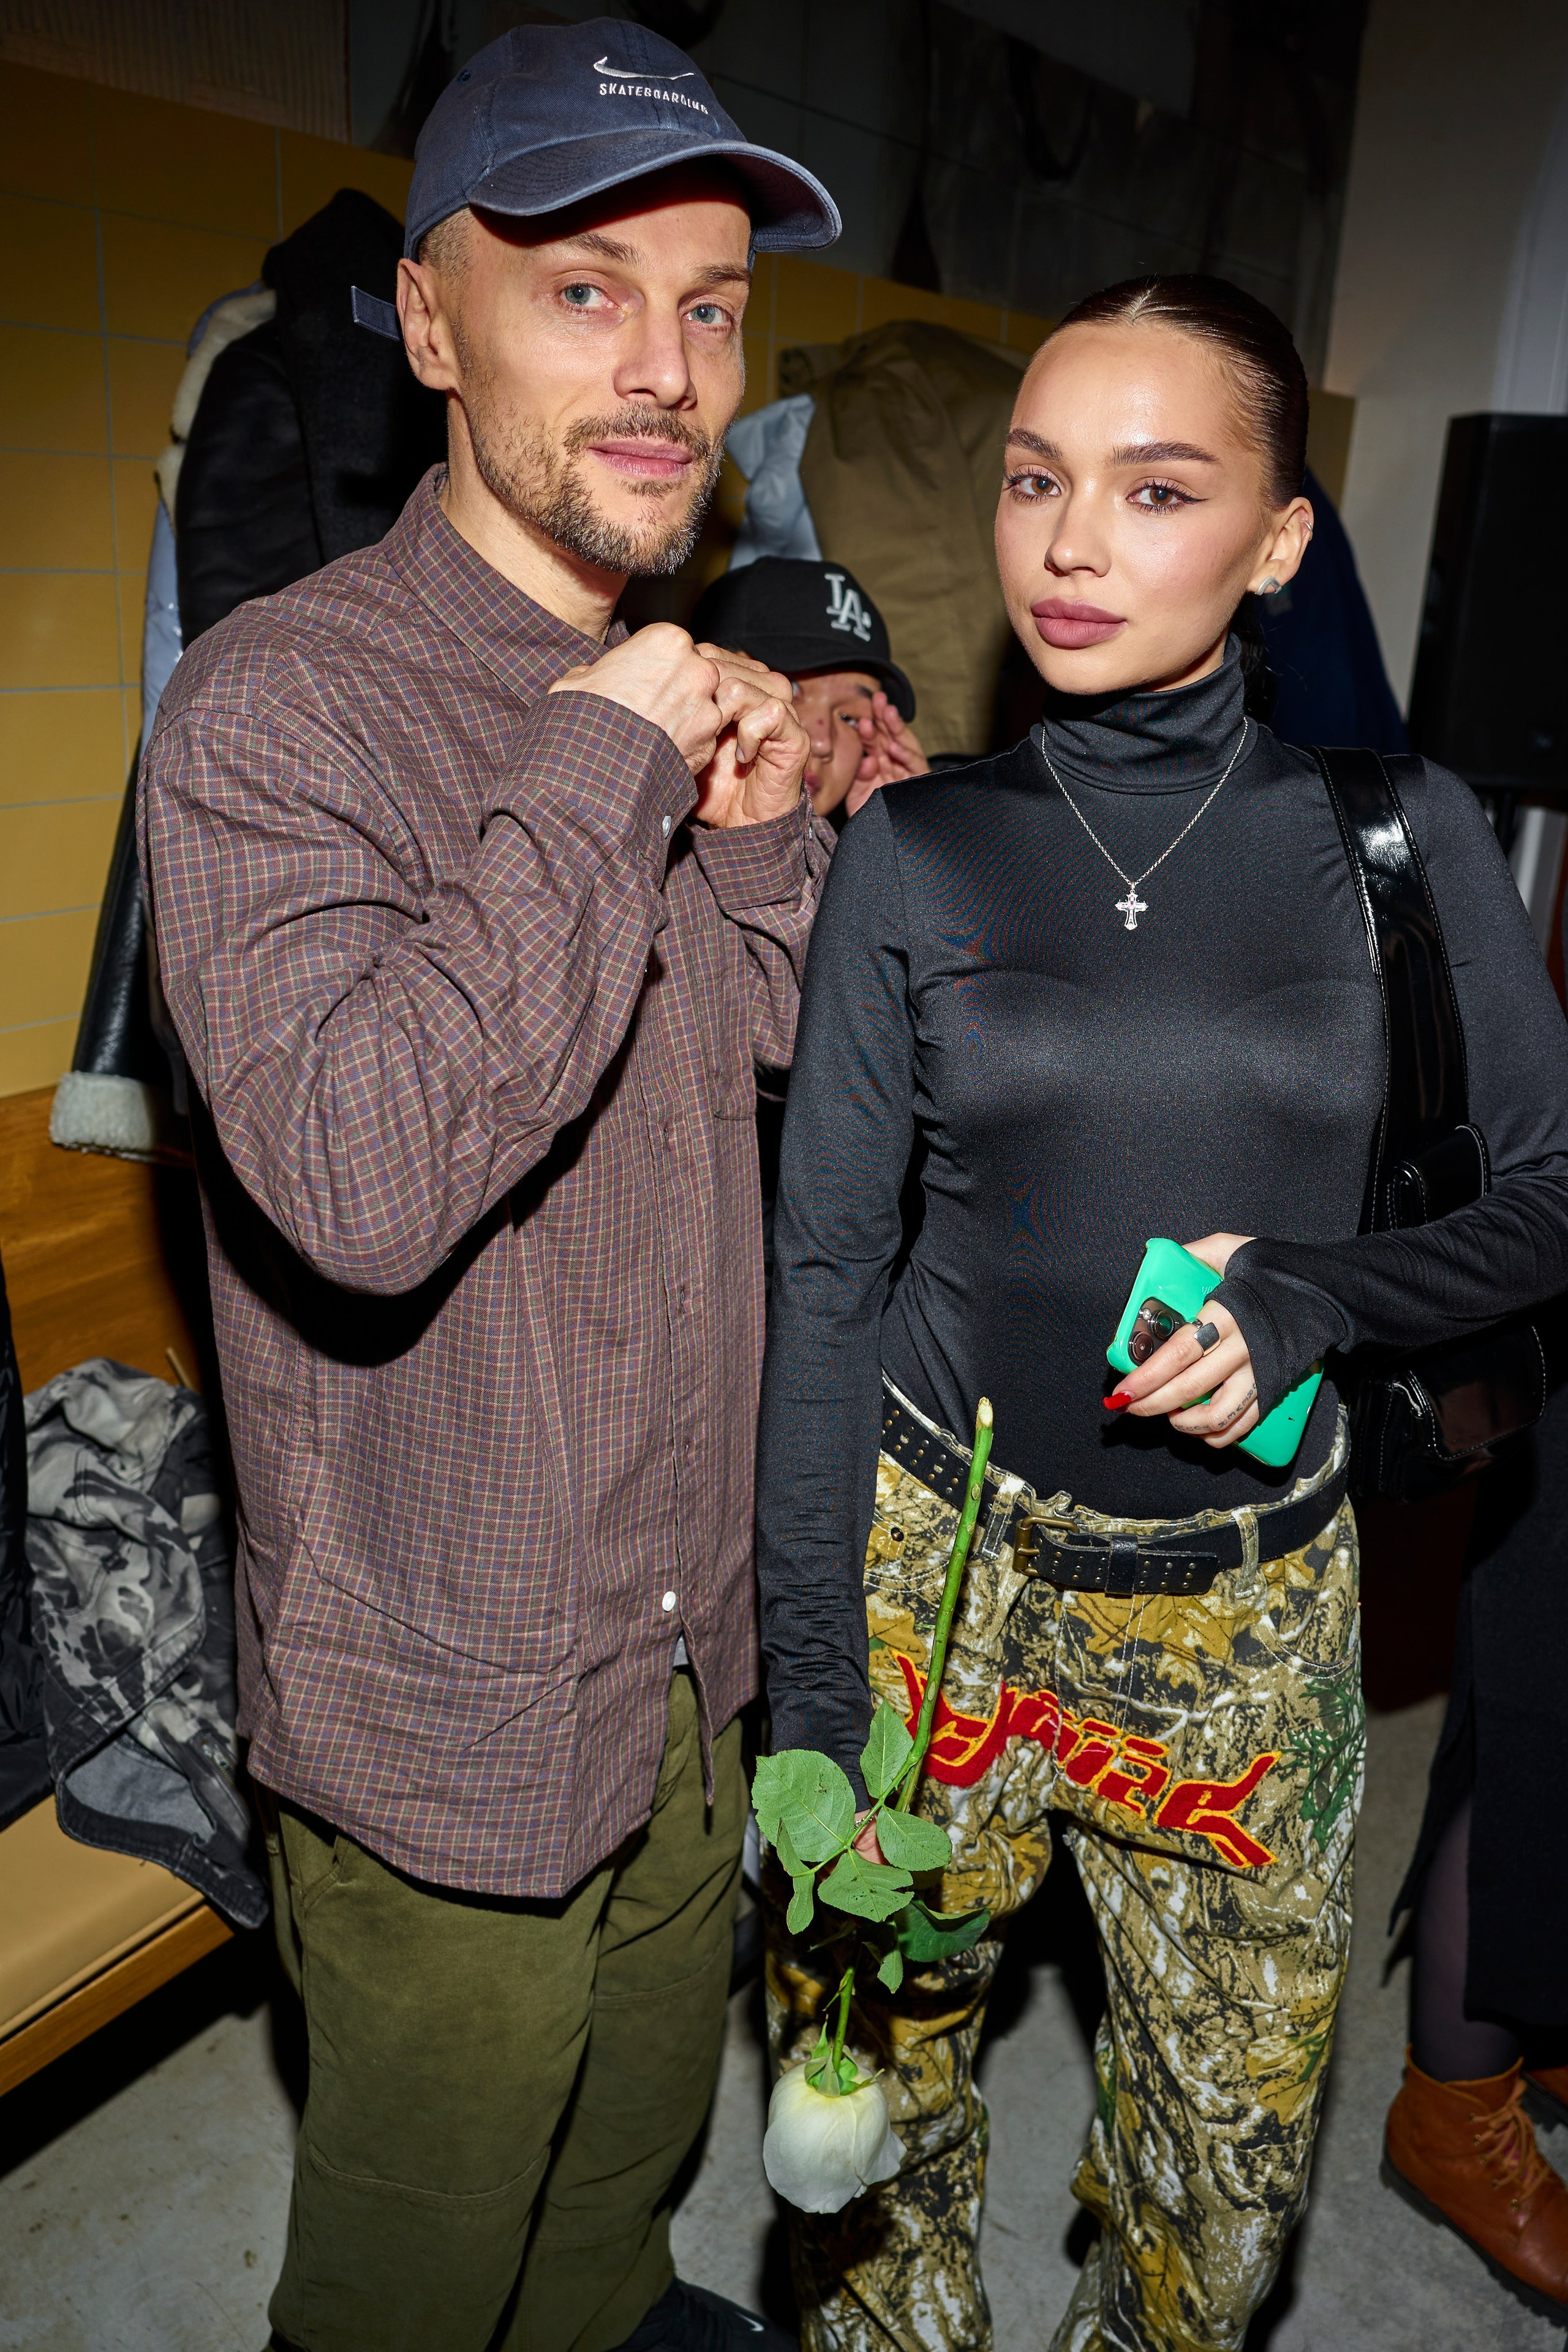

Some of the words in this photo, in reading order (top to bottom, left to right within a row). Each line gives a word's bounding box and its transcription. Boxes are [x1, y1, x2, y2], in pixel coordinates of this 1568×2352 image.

[599, 83, 709, 115] SKATEBOARDING
[824, 573, 872, 641] LA
[1218, 1382, 1256, 1428] OREVER
